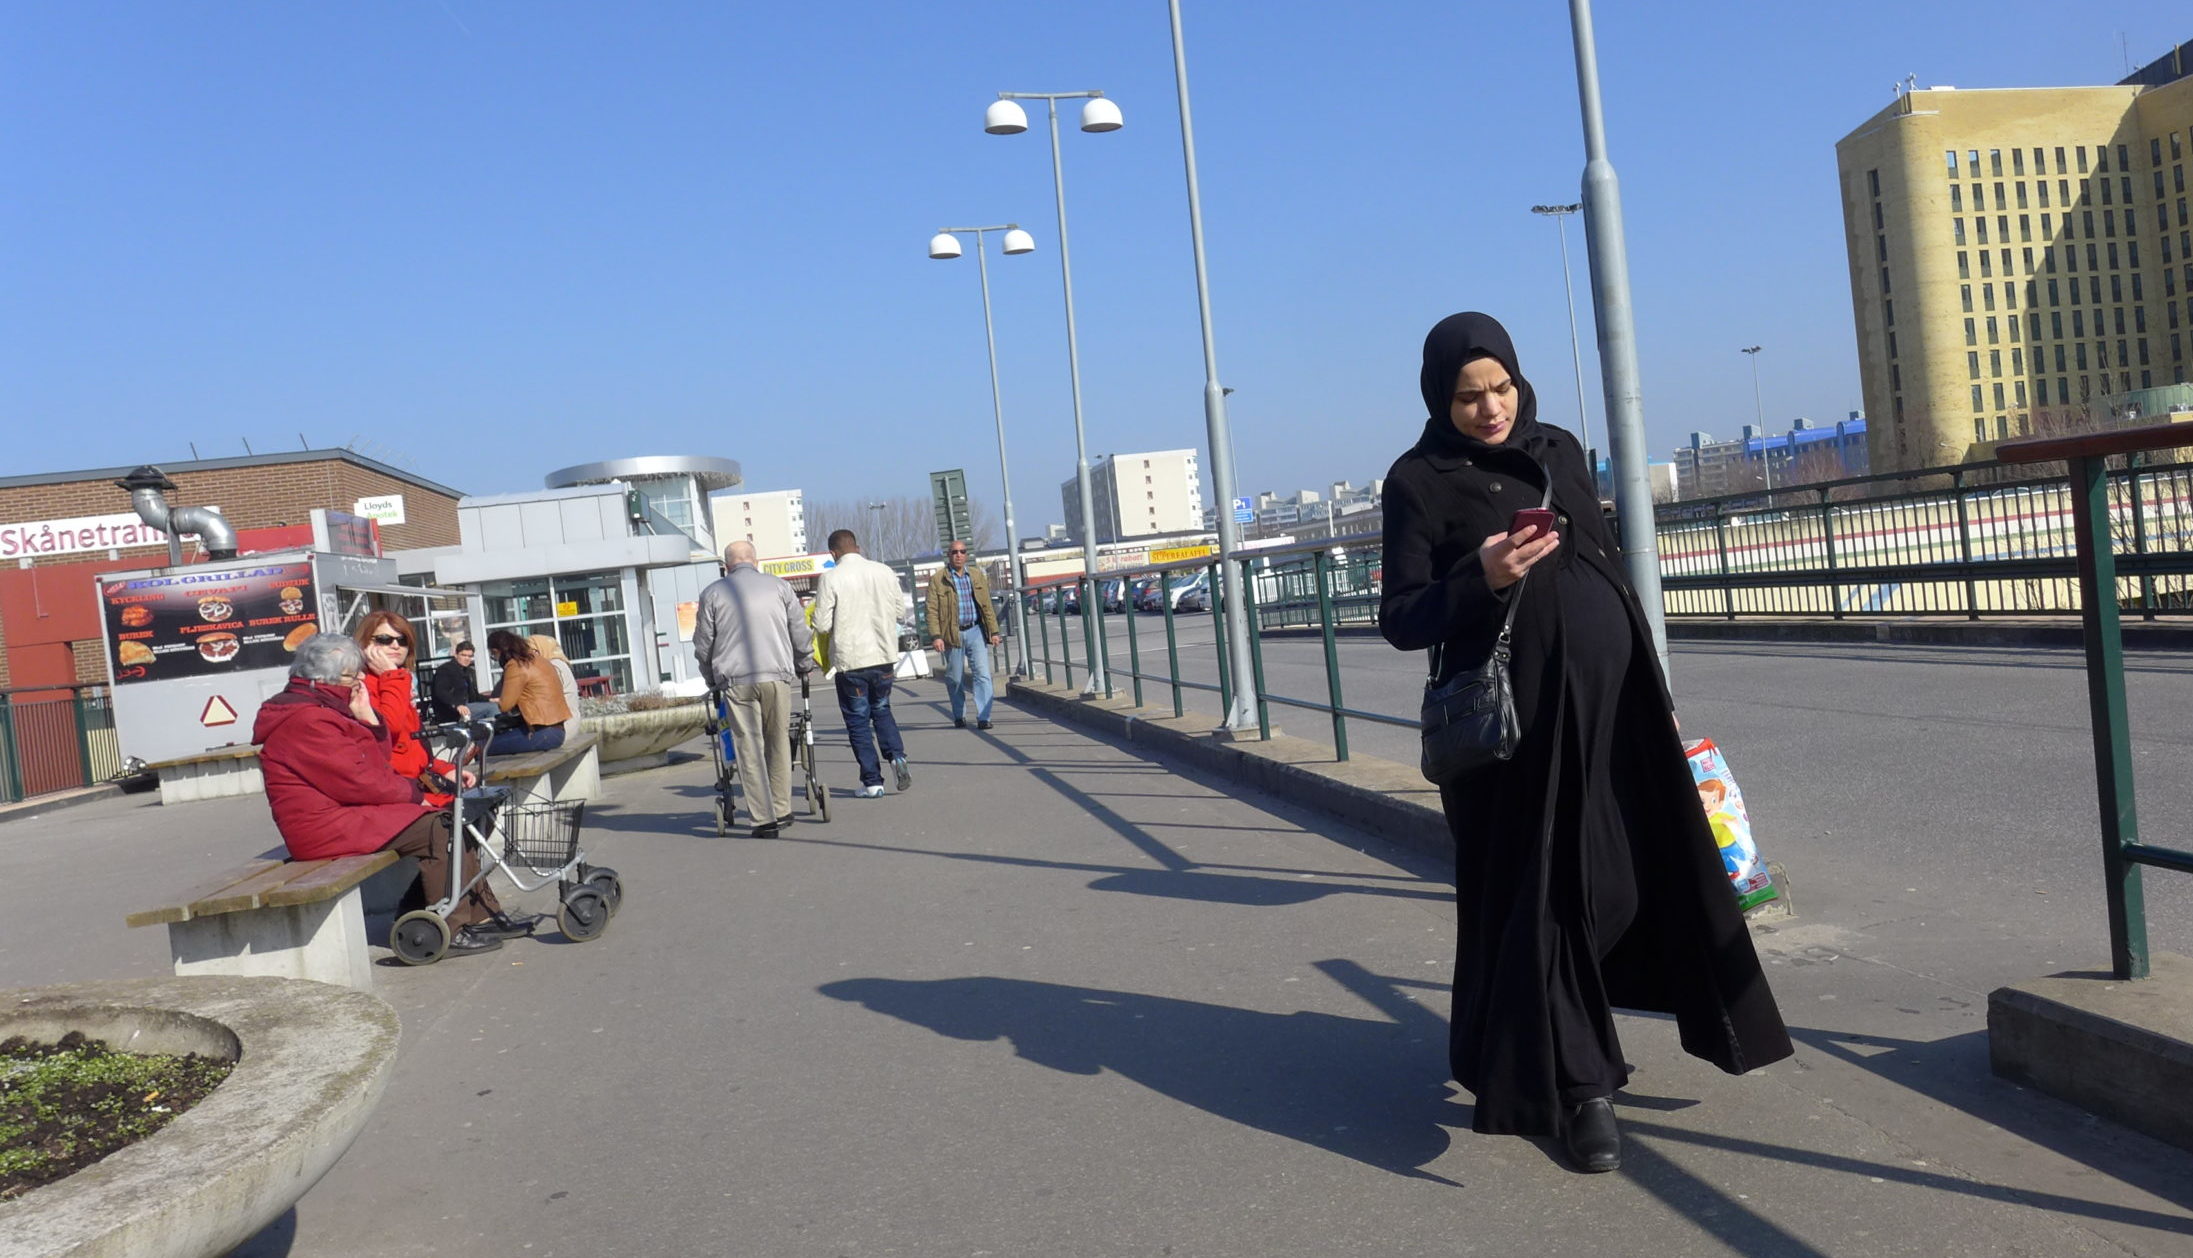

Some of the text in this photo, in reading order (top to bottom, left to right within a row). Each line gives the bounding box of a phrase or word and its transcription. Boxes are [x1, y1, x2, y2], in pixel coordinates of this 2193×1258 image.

[364, 501, 392, 511] Lloyds
[1, 519, 195, 556] Skånetraf
[763, 560, 813, 575] CITY GROSS
